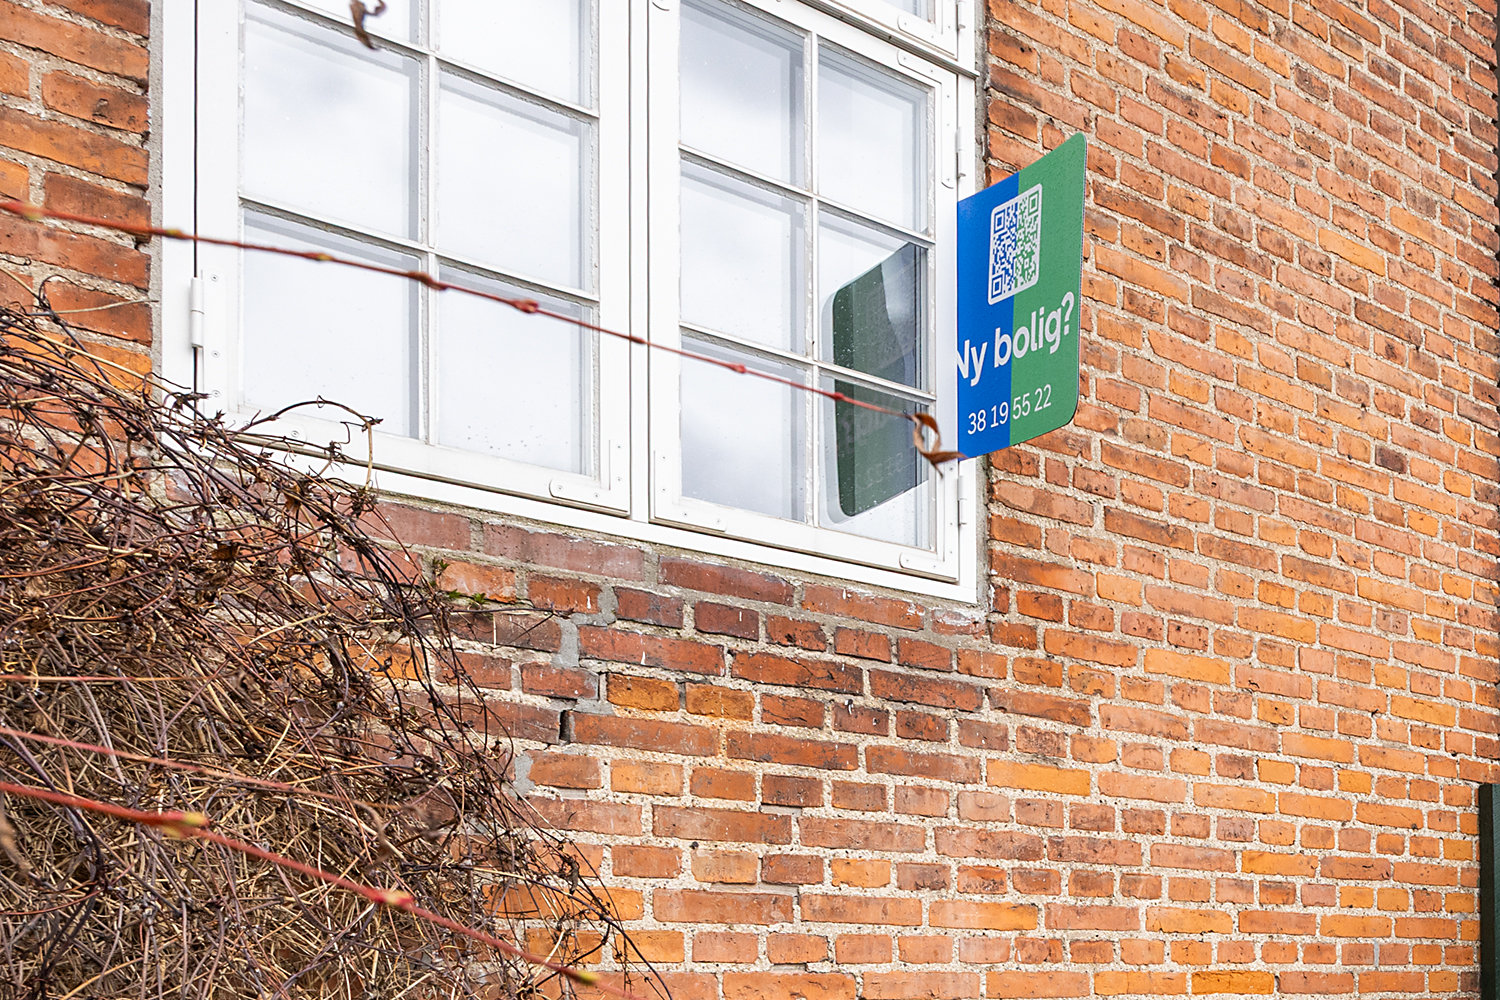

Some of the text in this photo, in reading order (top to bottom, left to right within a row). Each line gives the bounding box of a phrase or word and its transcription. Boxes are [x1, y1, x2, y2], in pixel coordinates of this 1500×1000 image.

[994, 292, 1074, 368] bolig?
[968, 384, 1052, 435] 38 19 55 22
